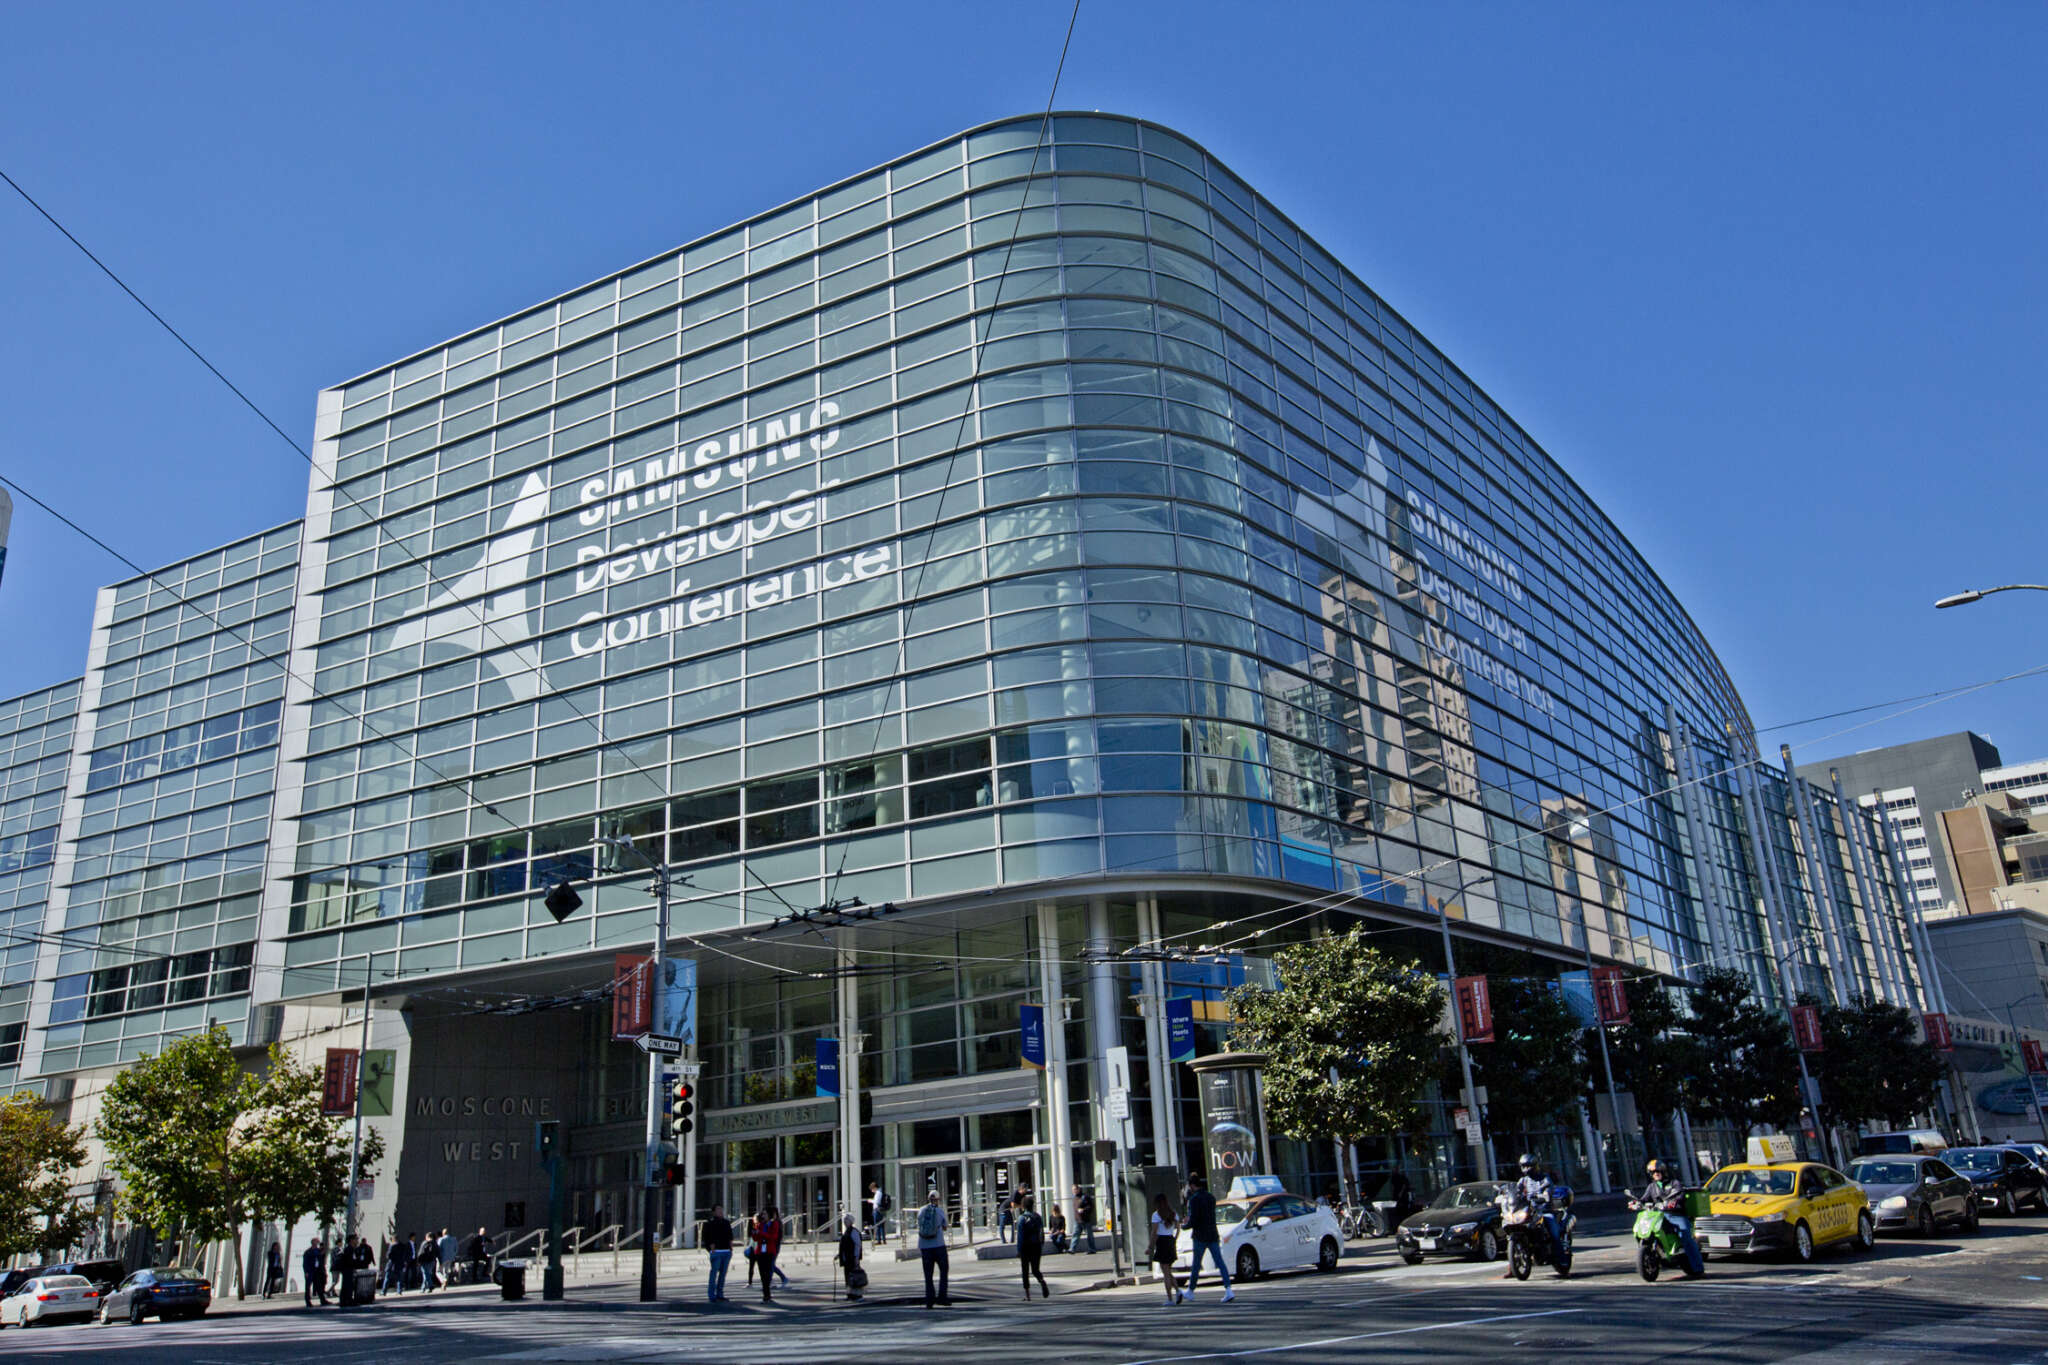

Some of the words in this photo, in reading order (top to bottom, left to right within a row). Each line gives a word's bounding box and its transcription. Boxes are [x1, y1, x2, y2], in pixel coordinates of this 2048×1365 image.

[579, 402, 840, 526] SAMSUNG
[576, 478, 840, 593] Developer
[570, 545, 891, 657] Conference
[1416, 549, 1528, 654] Developer
[649, 1040, 661, 1048] ONE
[416, 1097, 551, 1116] MOSCONE
[784, 1107, 817, 1124] WEST
[443, 1142, 520, 1161] WEST
[1211, 1147, 1254, 1170] how
